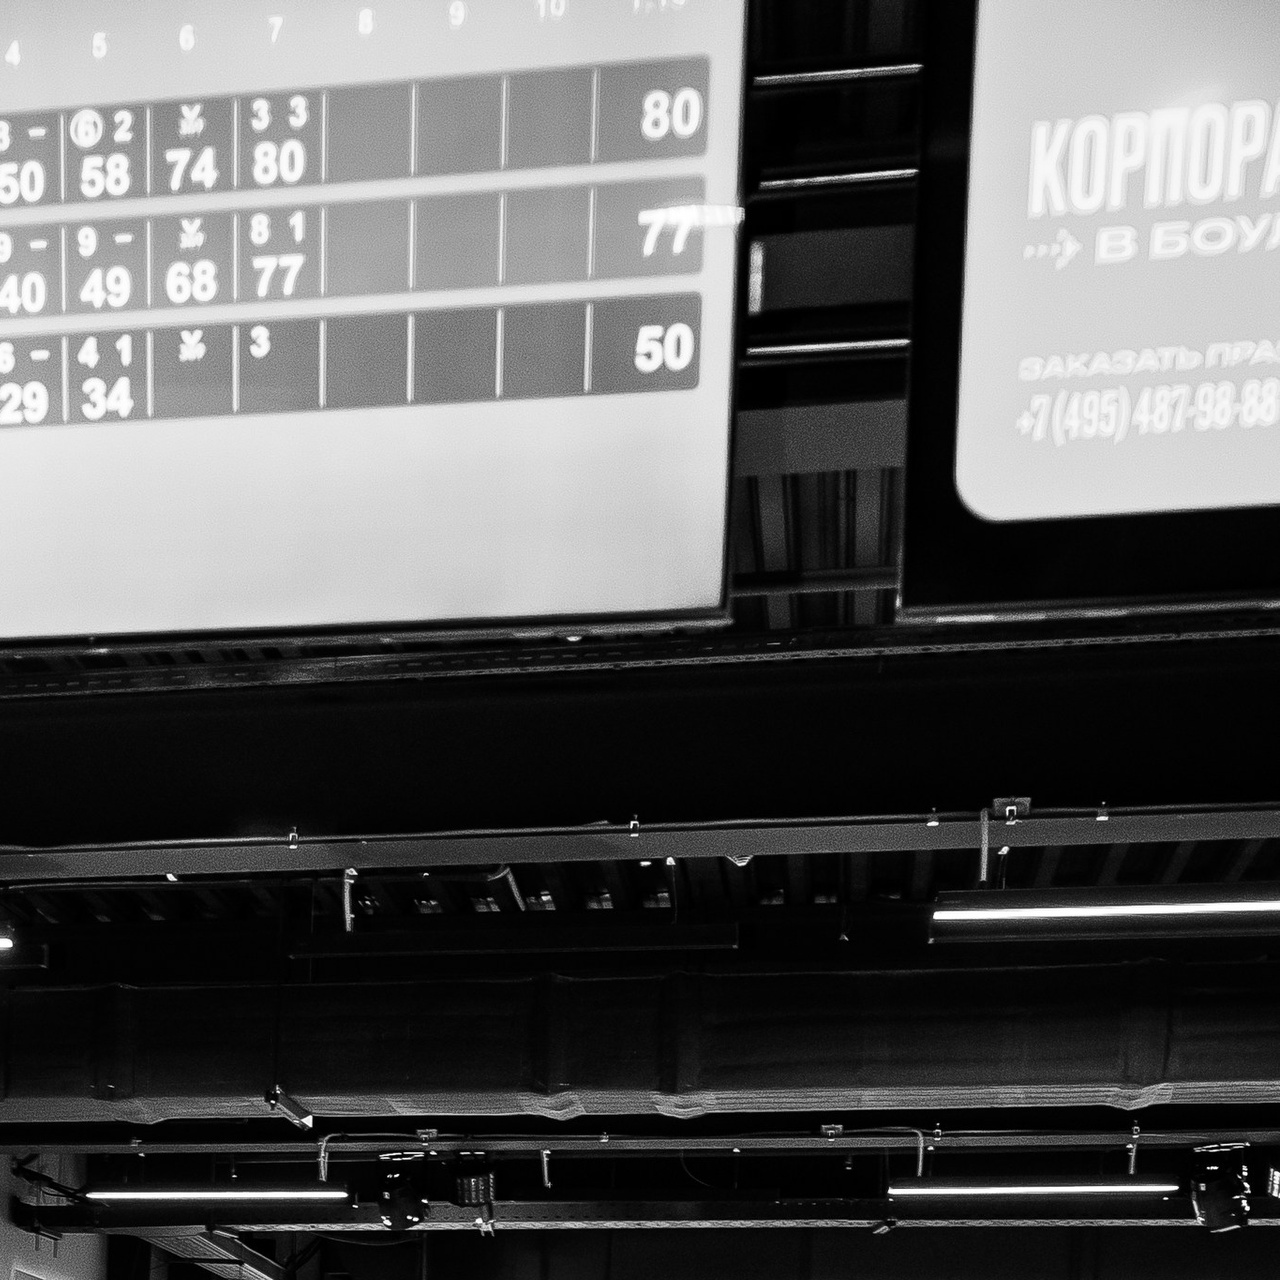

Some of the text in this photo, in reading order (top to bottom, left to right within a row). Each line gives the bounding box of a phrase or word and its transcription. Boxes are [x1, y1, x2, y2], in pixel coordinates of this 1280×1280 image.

[4, 40, 21, 66] 4
[92, 31, 108, 60] 5
[178, 24, 196, 51] 6
[268, 15, 284, 44] 7
[358, 8, 374, 35] 8
[449, 0, 466, 27] 9
[80, 153, 131, 198] 58
[165, 146, 219, 192] 74
[252, 139, 305, 185] 80
[641, 87, 703, 140] 80
[113, 109, 133, 143] 2
[251, 98, 271, 131] 3
[288, 95, 309, 129] 3
[77, 226, 97, 258] 9
[250, 213, 270, 245] 8
[289, 210, 305, 243] 1
[638, 205, 694, 257] 77
[1095, 227, 1138, 265] В
[79, 265, 132, 309] 49
[165, 259, 218, 304] 68
[252, 253, 305, 298] 77
[77, 336, 100, 369] 4
[115, 334, 132, 367] 1
[249, 325, 271, 358] 3
[81, 376, 134, 420] 34
[634, 322, 694, 373] 50
[1020, 340, 1280, 378] ЗАКАЗАТЬ ПРА
